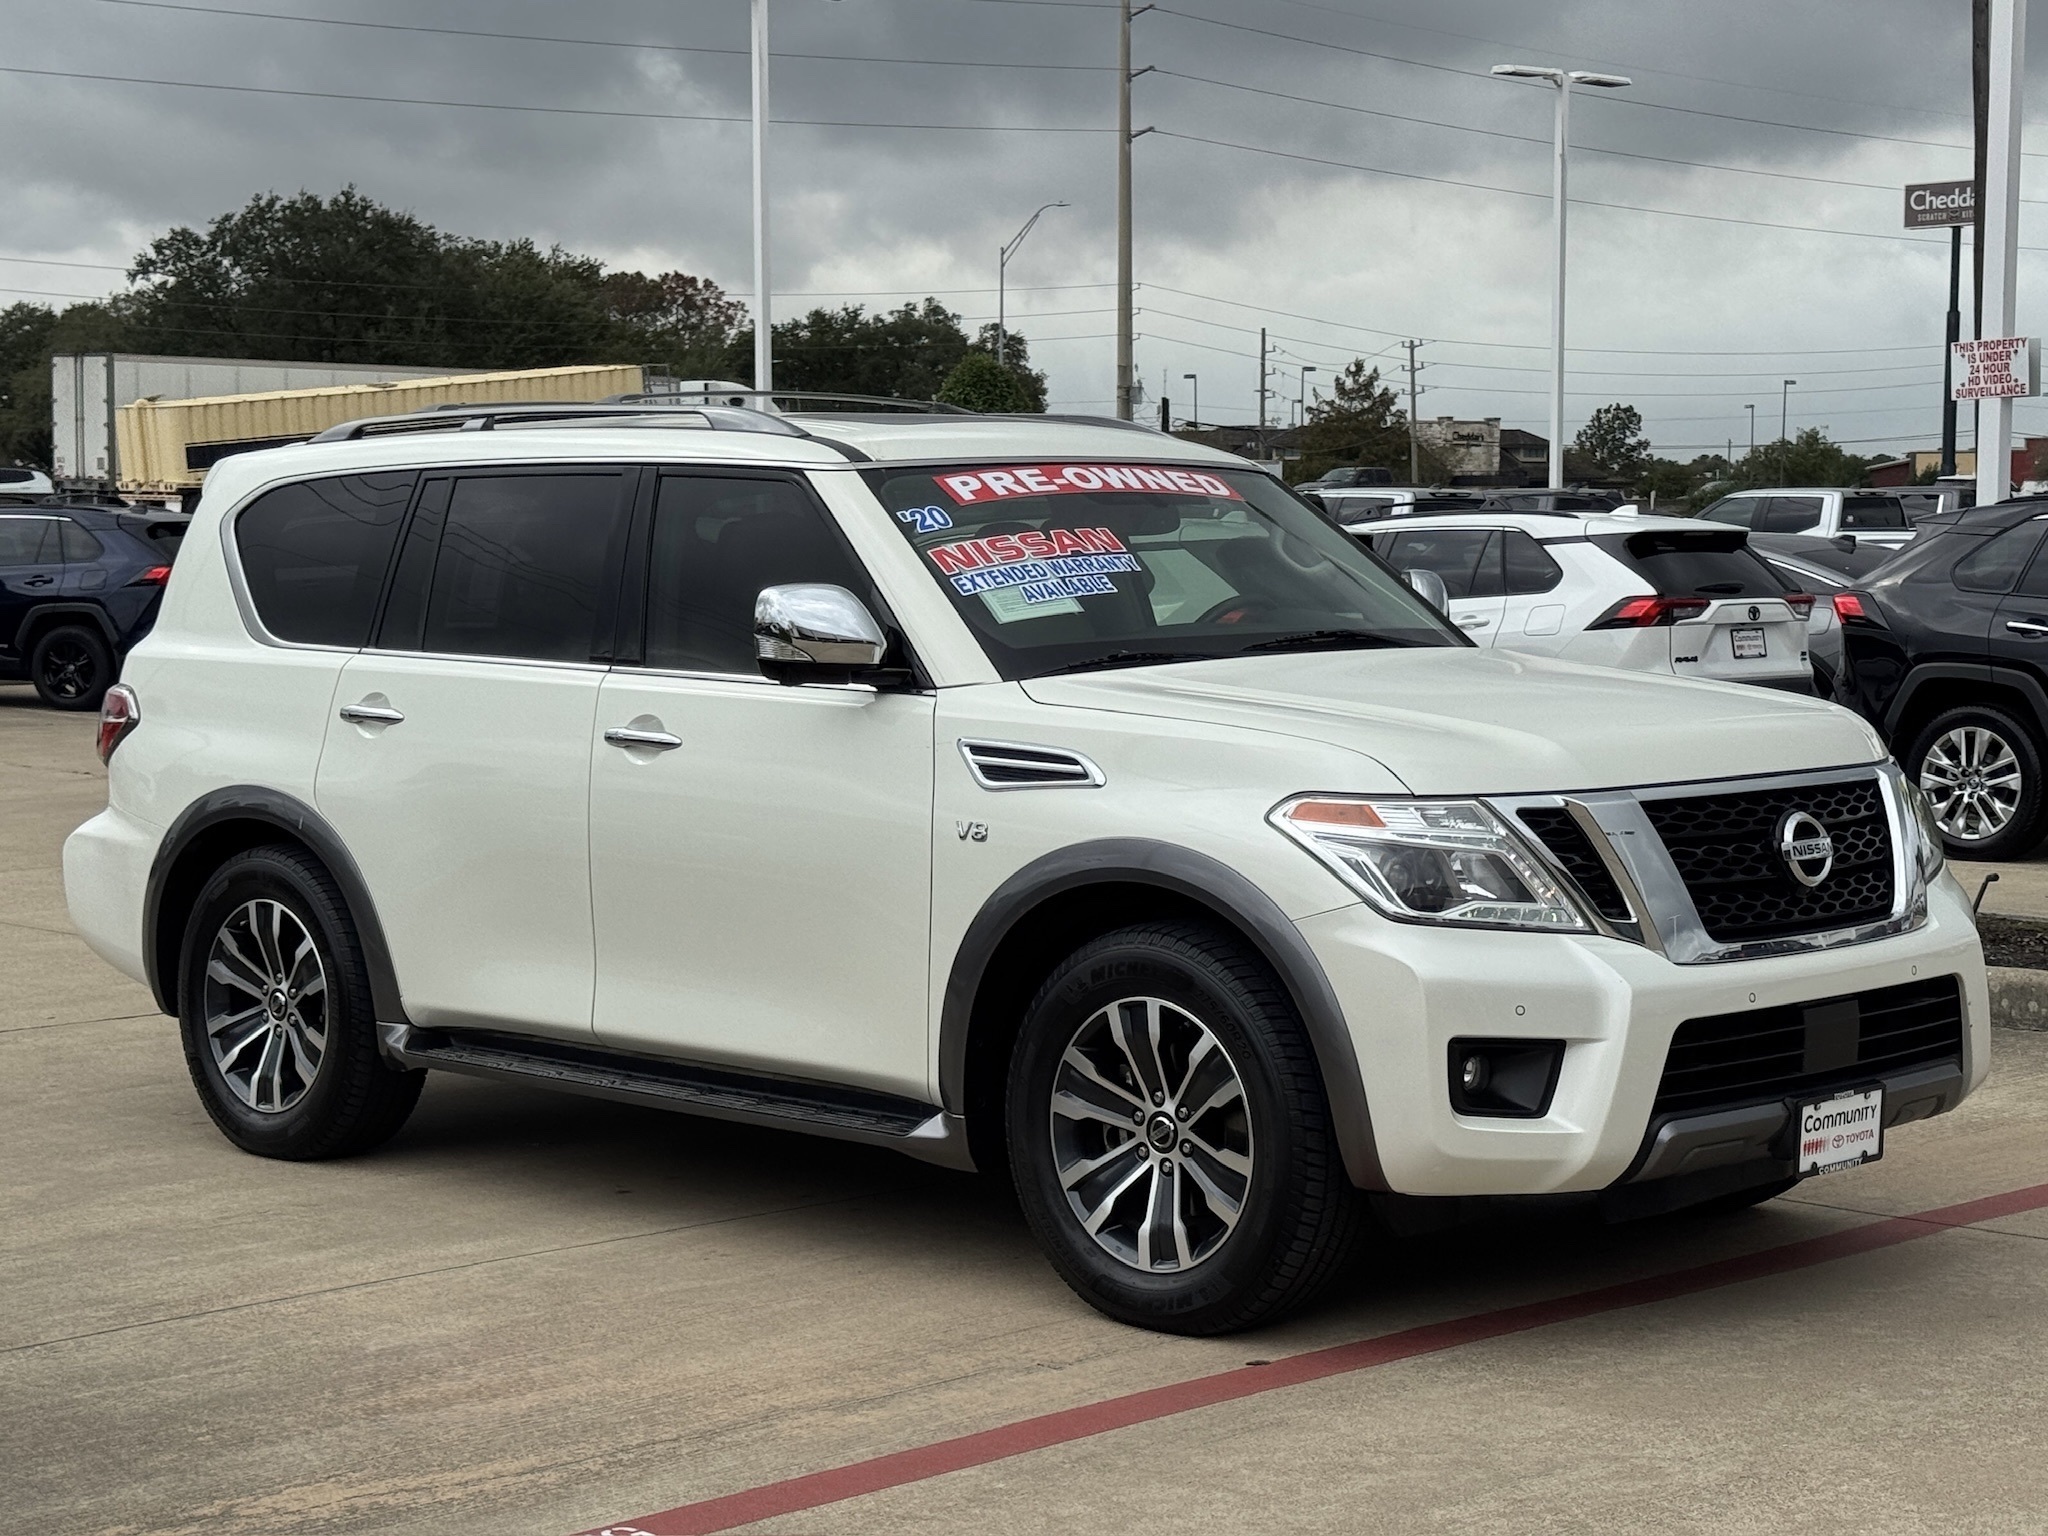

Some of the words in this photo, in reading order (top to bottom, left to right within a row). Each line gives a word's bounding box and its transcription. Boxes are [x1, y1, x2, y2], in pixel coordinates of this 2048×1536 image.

[1953, 342, 1974, 353] THIS
[1977, 337, 2028, 352] PROPERTY
[1967, 353, 1976, 364] IS
[1979, 350, 2012, 363] UNDER
[1969, 365, 1980, 375] 24
[1983, 362, 2010, 374] HOUR
[1968, 376, 1980, 387] HD
[1983, 373, 2012, 385] VIDEO
[1955, 383, 2026, 398] SURVEILLANCE
[943, 467, 1231, 501] PRE-OWNED
[928, 528, 1124, 574] NISSAN
[952, 566, 1048, 595] EXTENDED
[1050, 555, 1141, 577] WARRANTY
[1021, 575, 1116, 603] AVAILABLE
[956, 821, 988, 841] V8
[1792, 842, 1832, 858] NISSAN
[1846, 1129, 1874, 1144] TOYOTA
[1818, 1158, 1864, 1175] COMMUNITY
